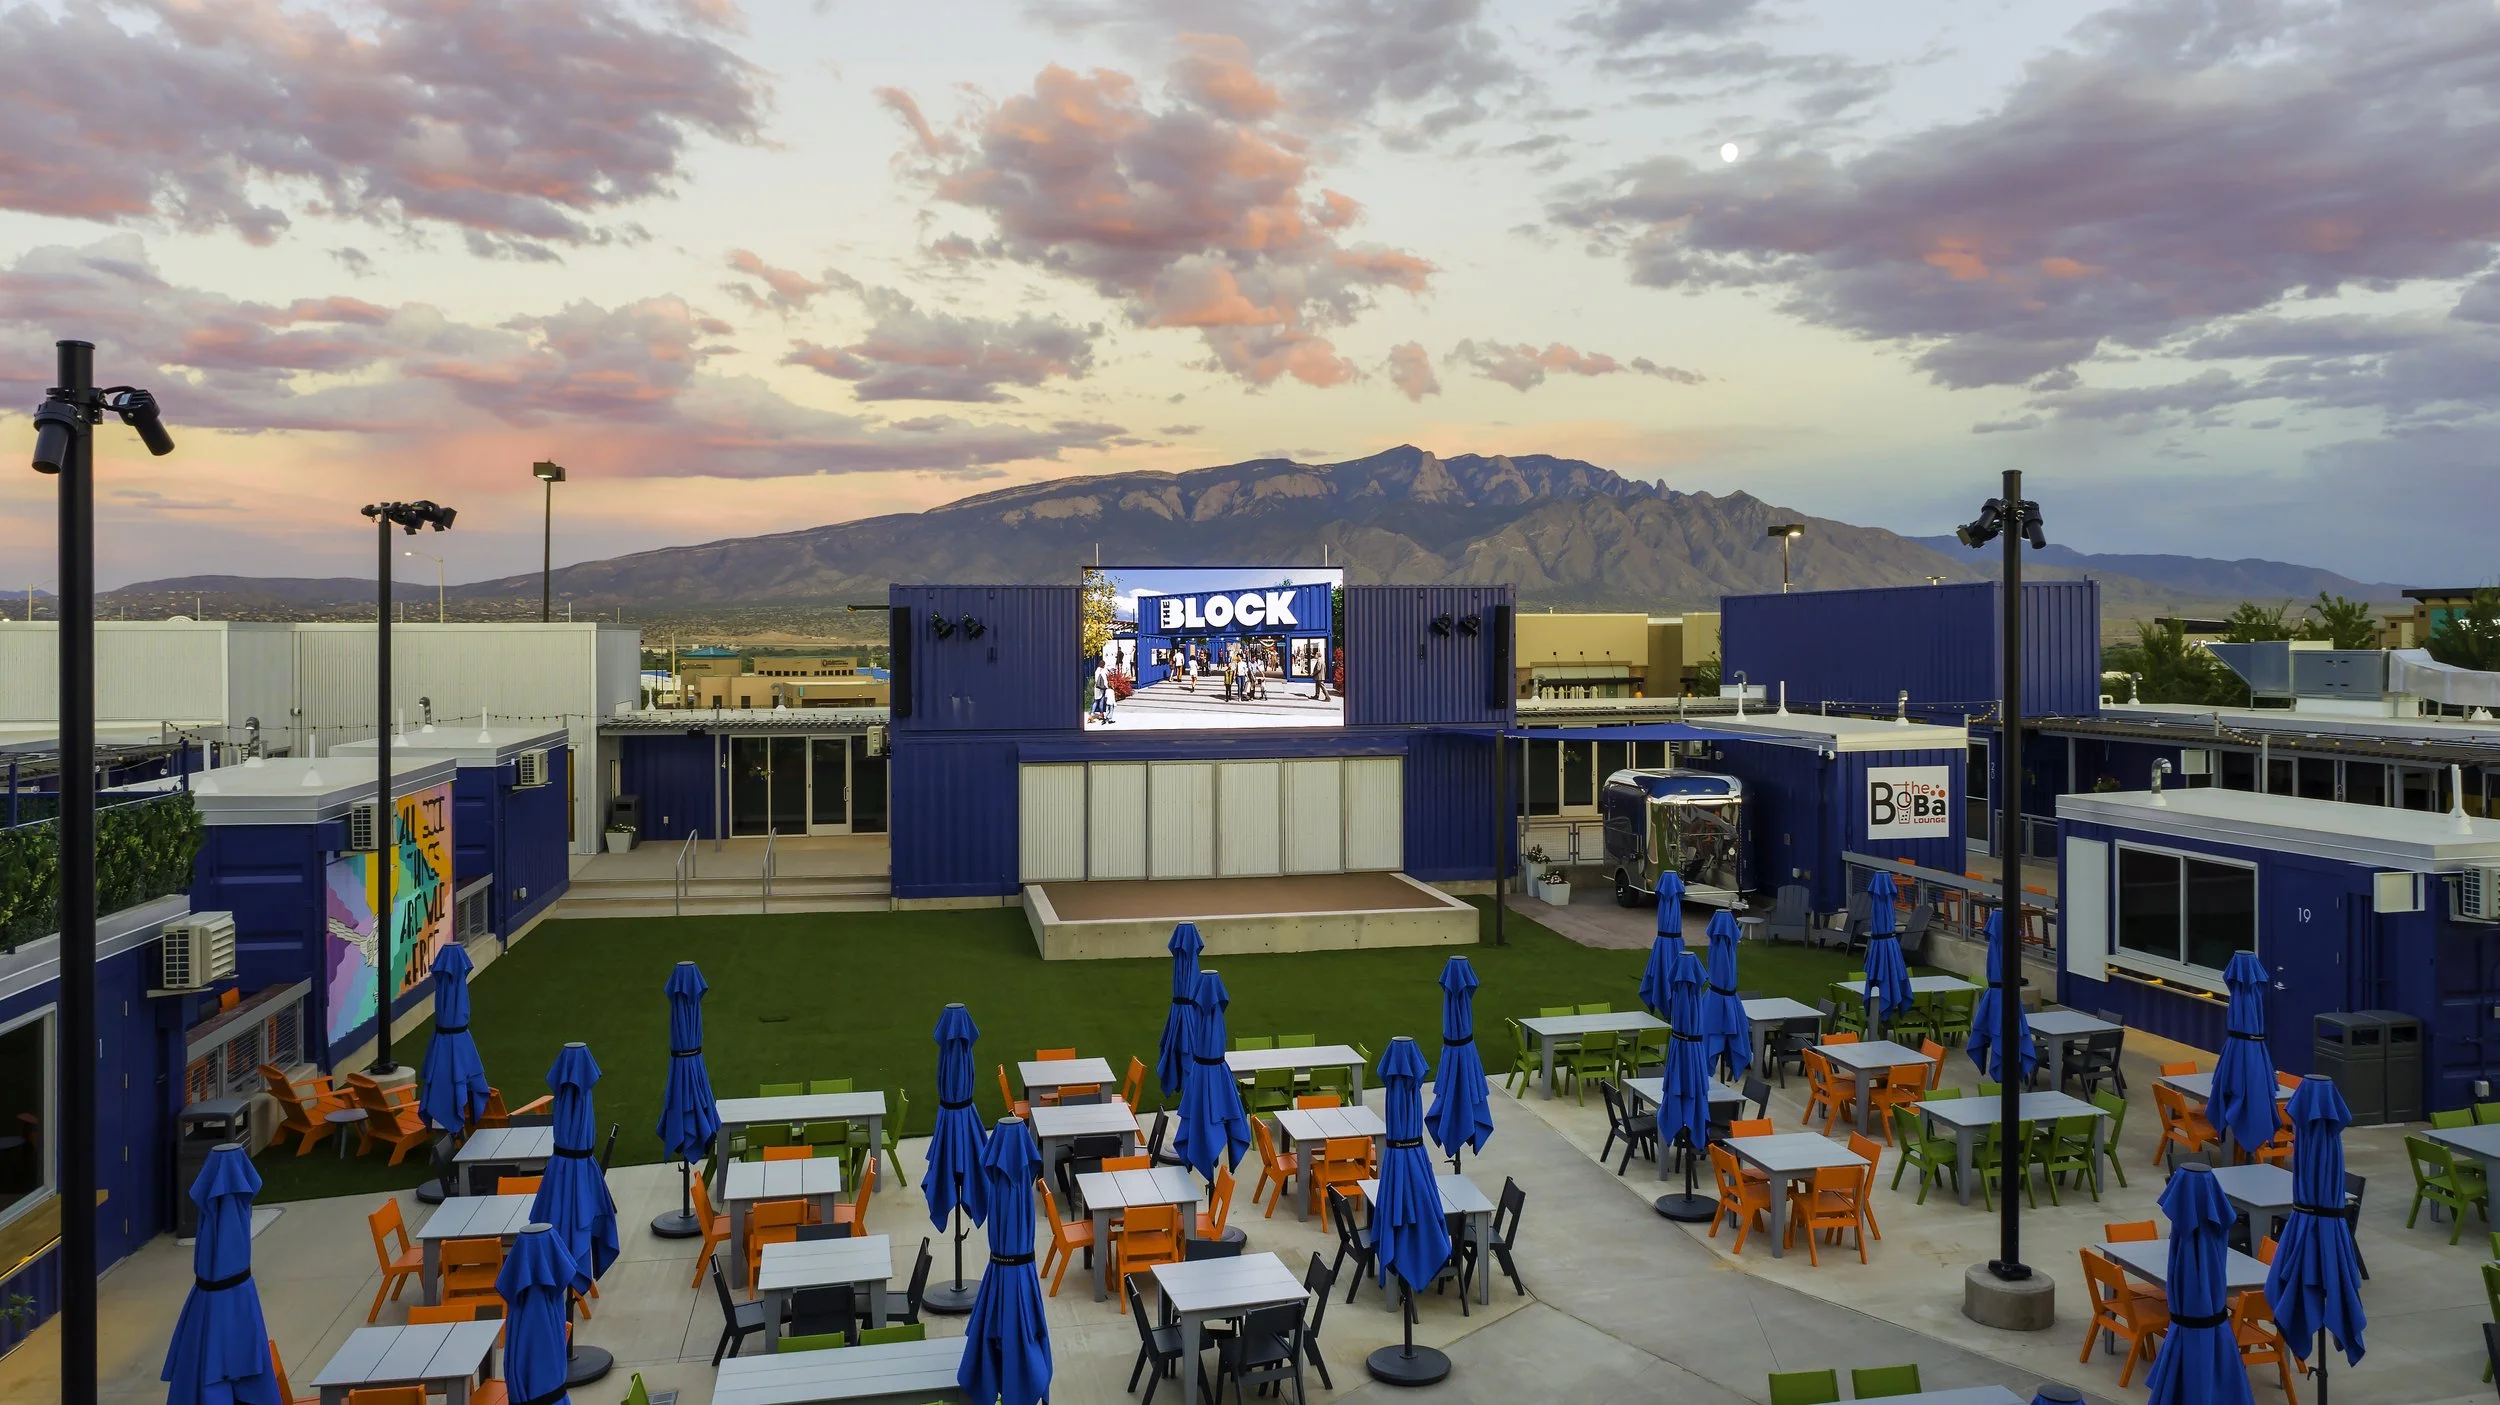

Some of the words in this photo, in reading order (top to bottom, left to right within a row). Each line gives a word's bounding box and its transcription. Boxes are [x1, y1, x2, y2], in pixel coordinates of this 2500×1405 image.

[1160, 591, 1298, 629] BLOCK
[1893, 781, 1930, 803] the
[2298, 907, 2311, 923] 19
